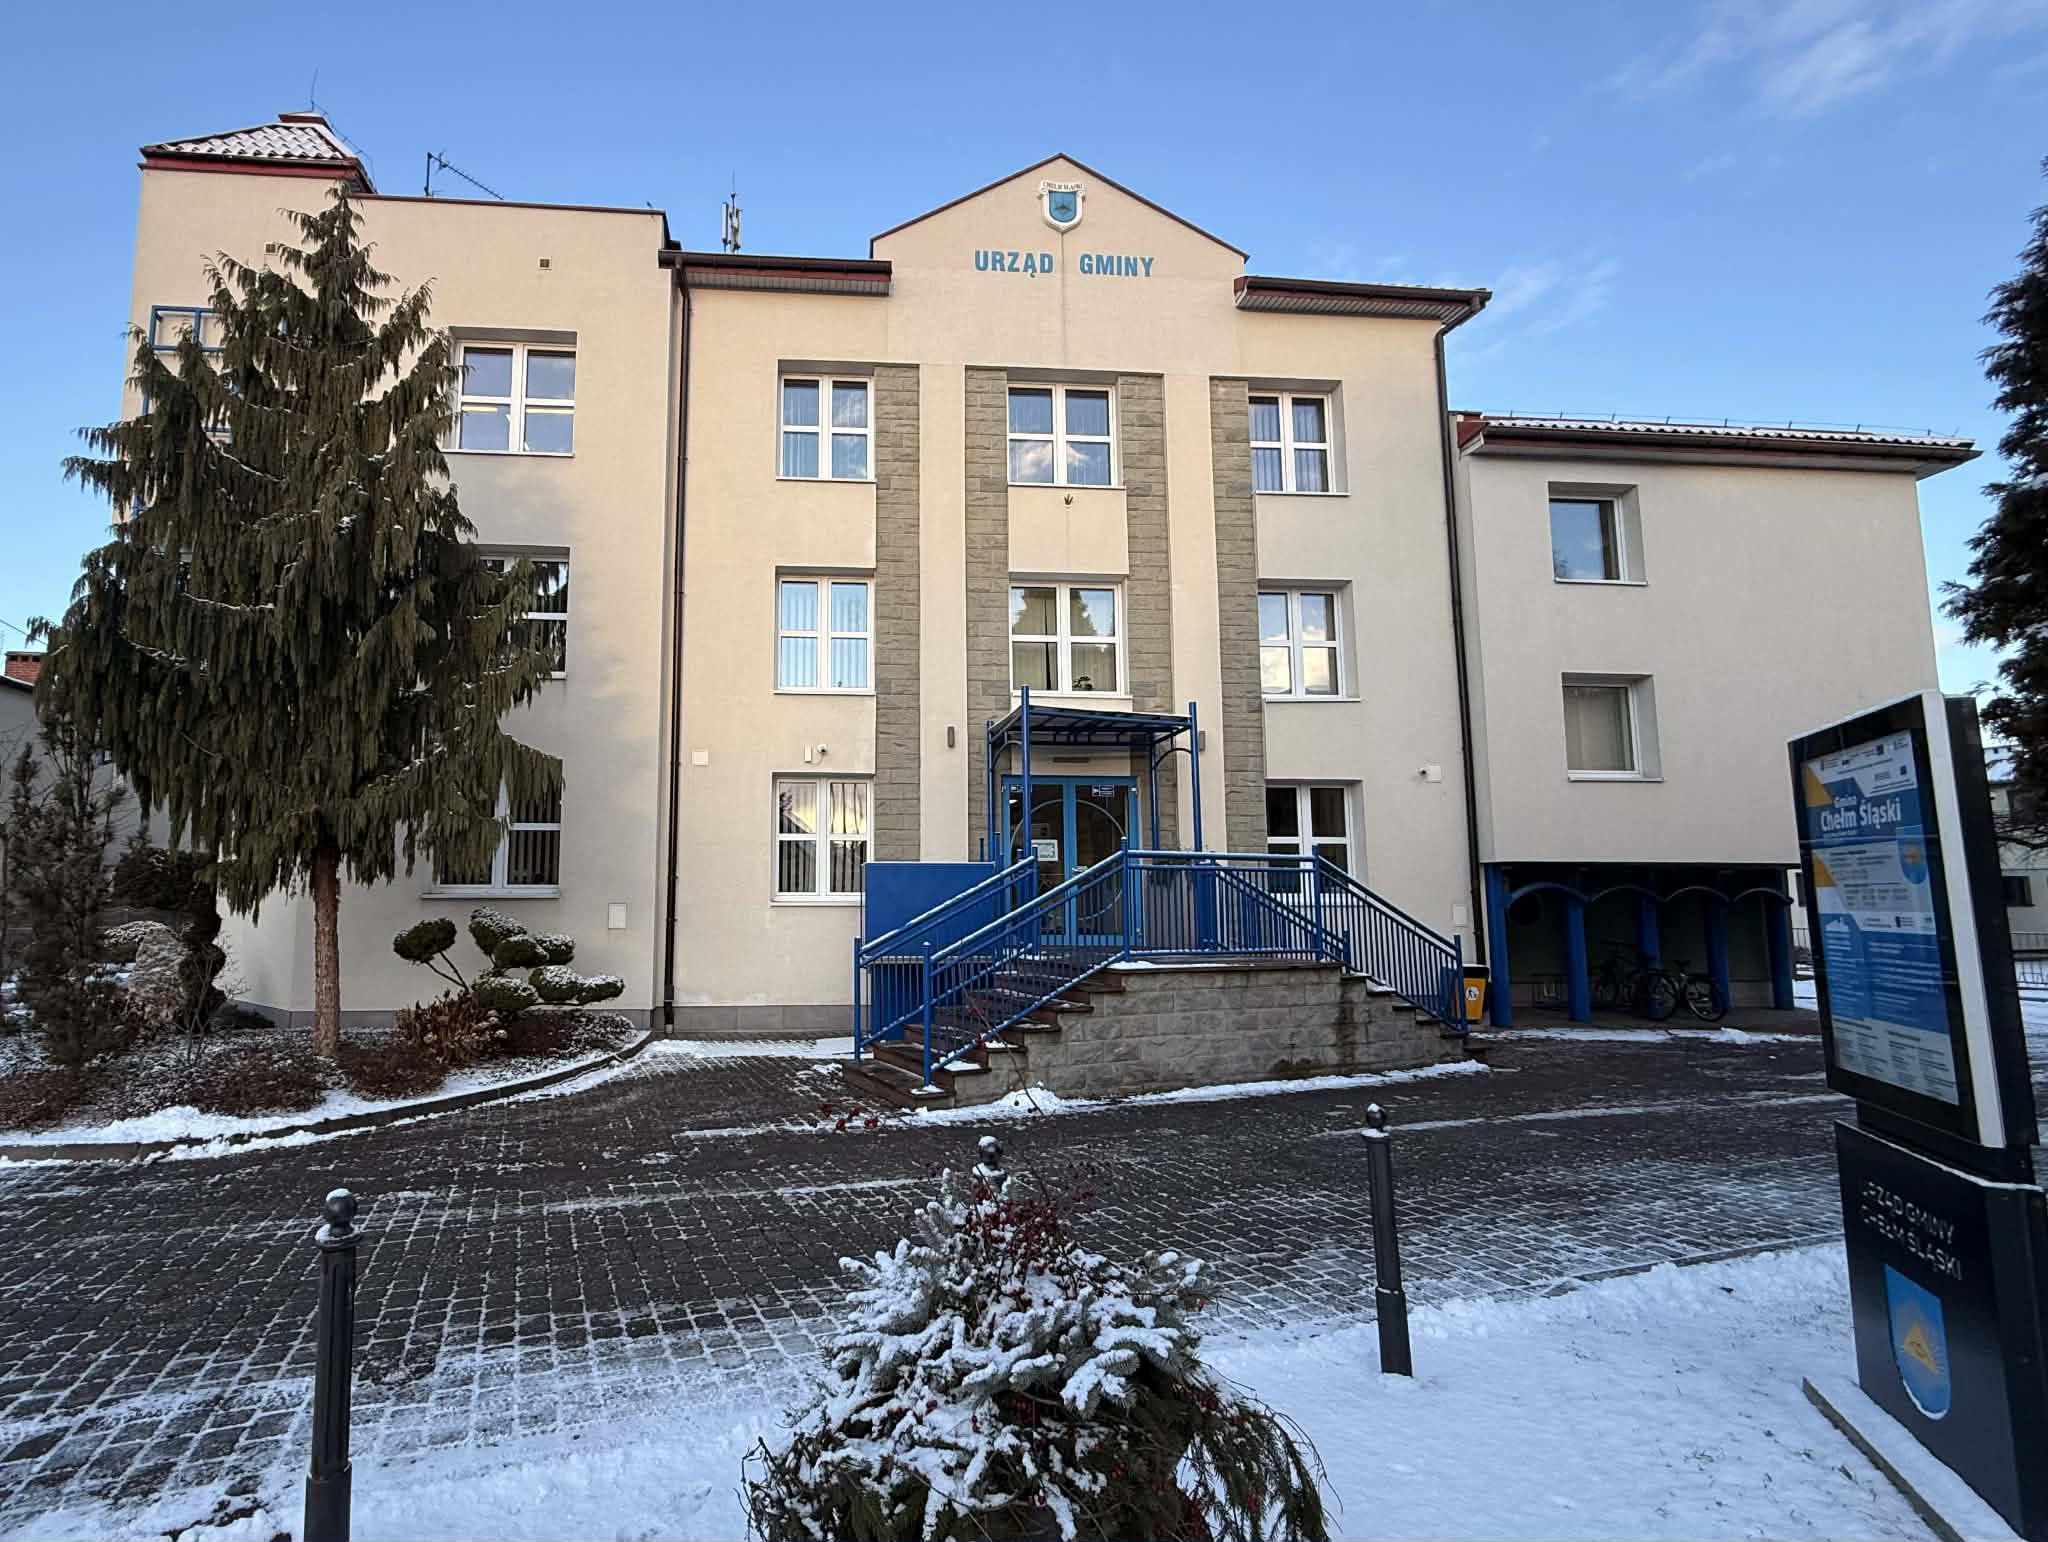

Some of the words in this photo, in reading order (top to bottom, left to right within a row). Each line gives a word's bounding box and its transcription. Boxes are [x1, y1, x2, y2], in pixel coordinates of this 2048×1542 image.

[975, 250, 1054, 278] URZĄD
[1079, 253, 1154, 277] GMINY
[1859, 797, 1901, 829] Śląski
